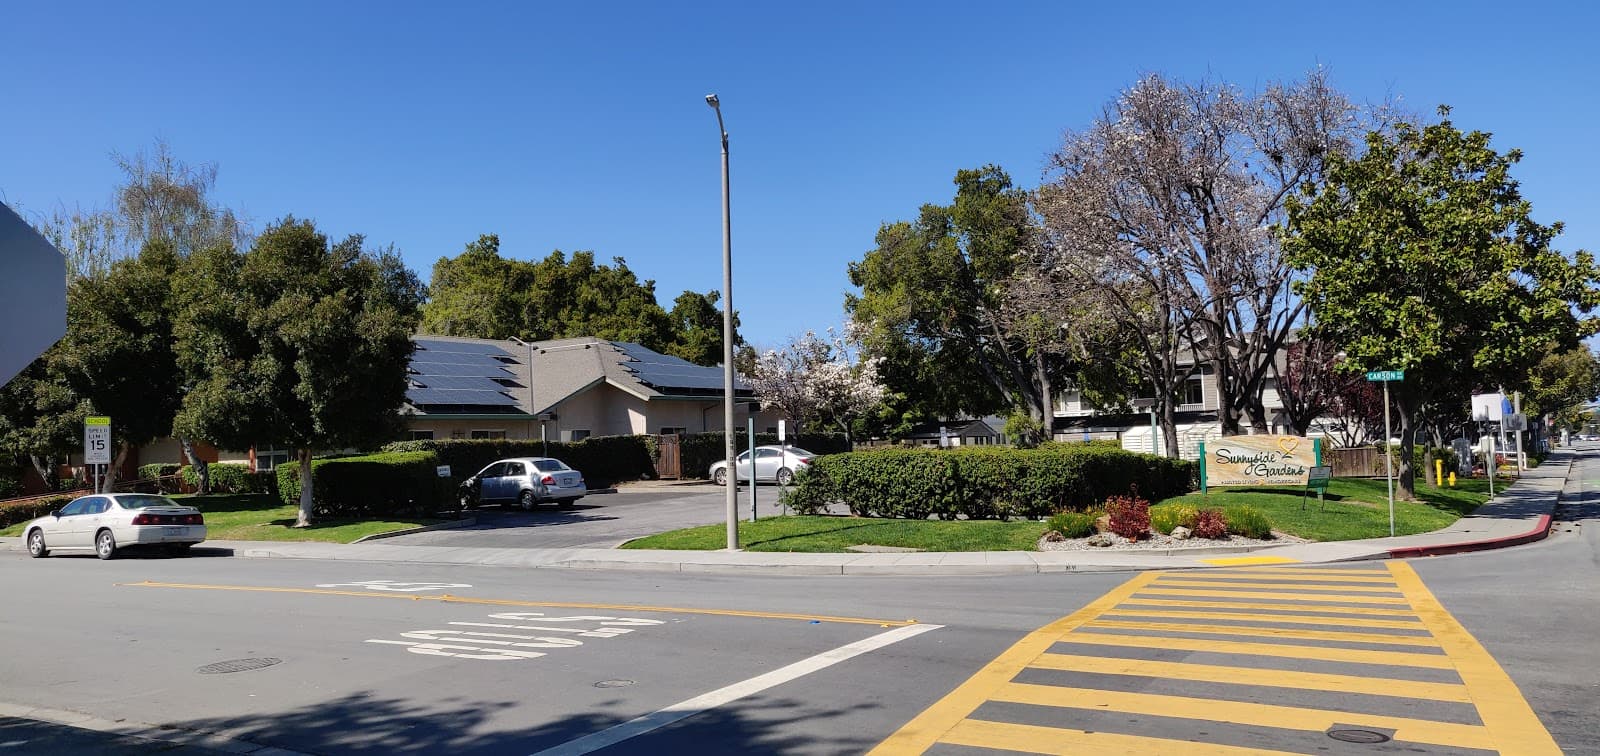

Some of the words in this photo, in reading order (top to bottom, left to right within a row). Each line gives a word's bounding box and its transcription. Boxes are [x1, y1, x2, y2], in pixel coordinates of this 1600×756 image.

[1368, 372, 1396, 380] CARSON
[91, 440, 105, 450] 15
[1216, 448, 1277, 475] Sunnyside
[1254, 463, 1305, 478] Gardens
[363, 612, 666, 660] STOP
